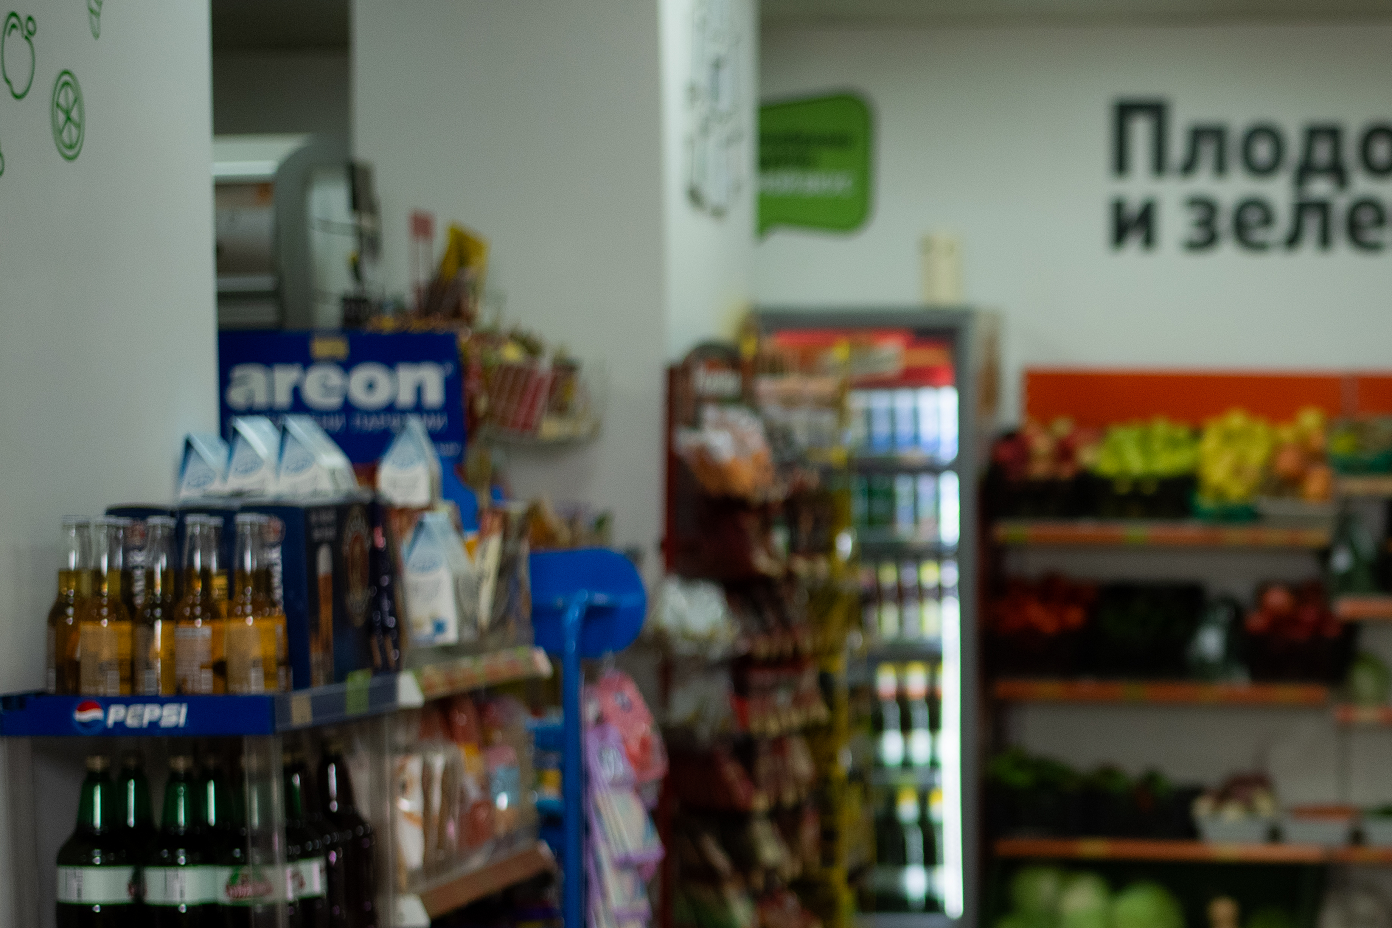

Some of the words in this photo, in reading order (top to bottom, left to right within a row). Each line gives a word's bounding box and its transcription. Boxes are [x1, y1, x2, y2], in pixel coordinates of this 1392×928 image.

[1112, 198, 1157, 250] и
[227, 361, 445, 410] areon
[107, 703, 188, 728] PEPSI
